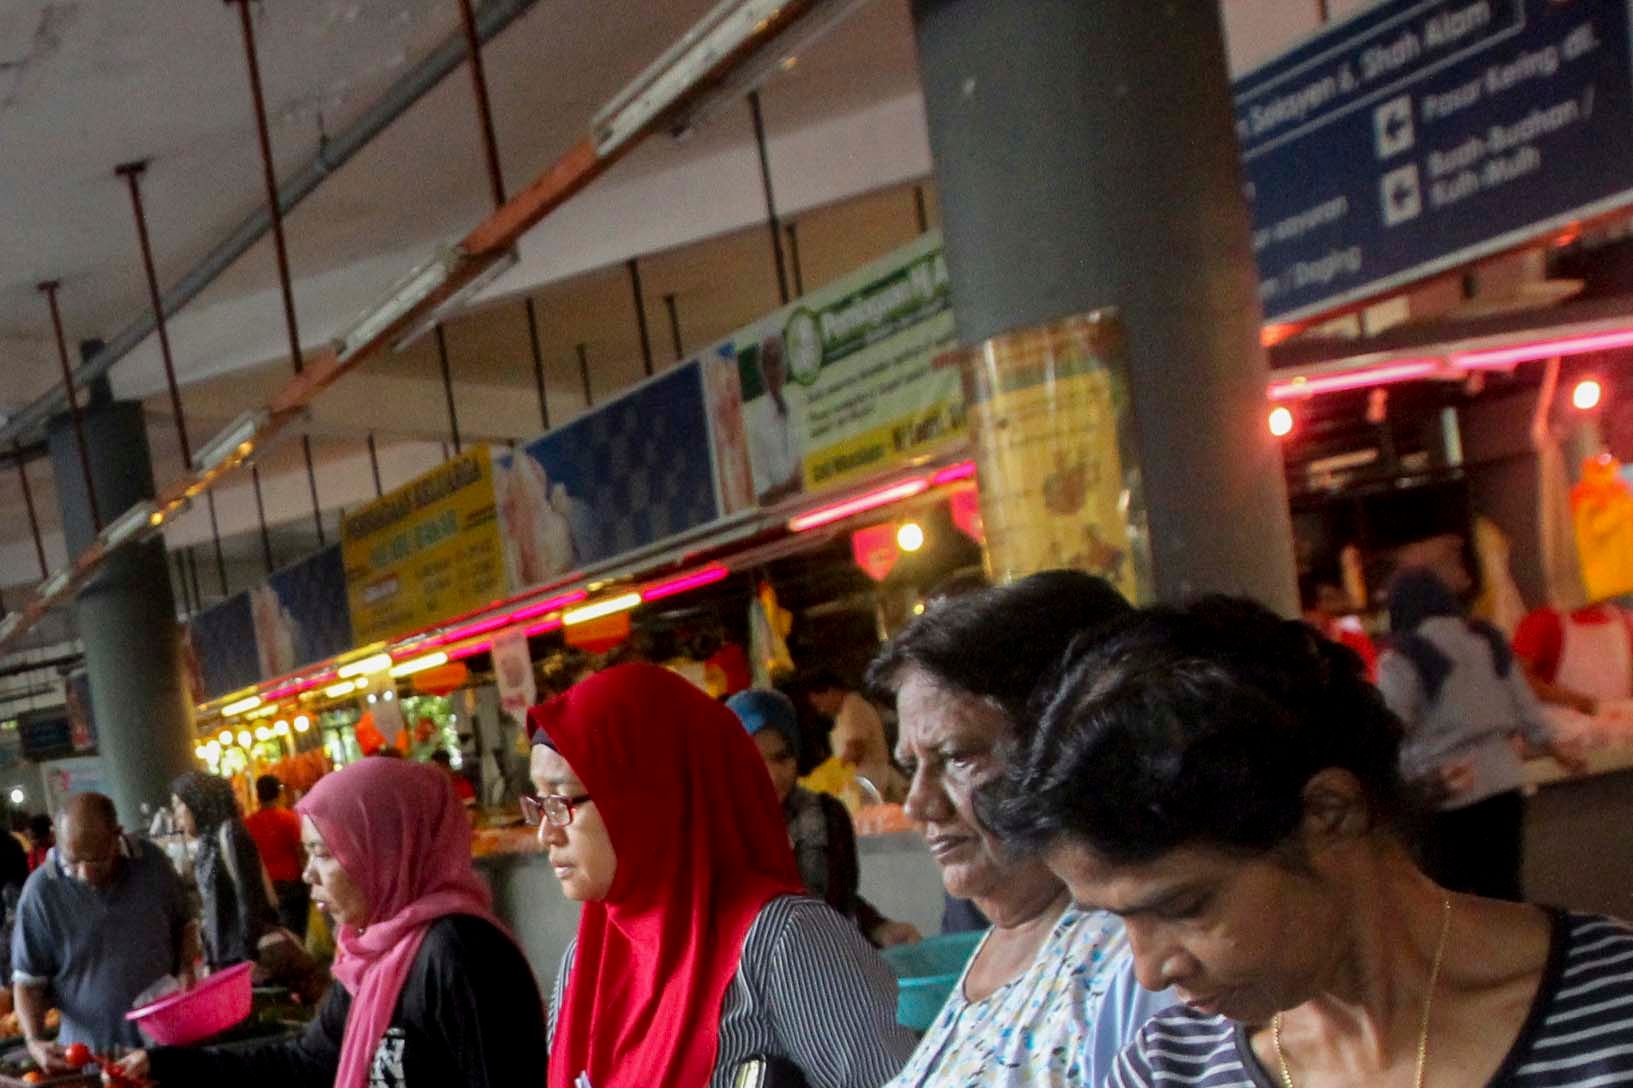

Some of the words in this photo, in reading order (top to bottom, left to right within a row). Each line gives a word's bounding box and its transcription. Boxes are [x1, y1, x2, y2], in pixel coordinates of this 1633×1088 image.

[1361, 32, 1420, 79] Shah
[1424, 1, 1490, 47] Alam
[1423, 80, 1482, 122] Pasar
